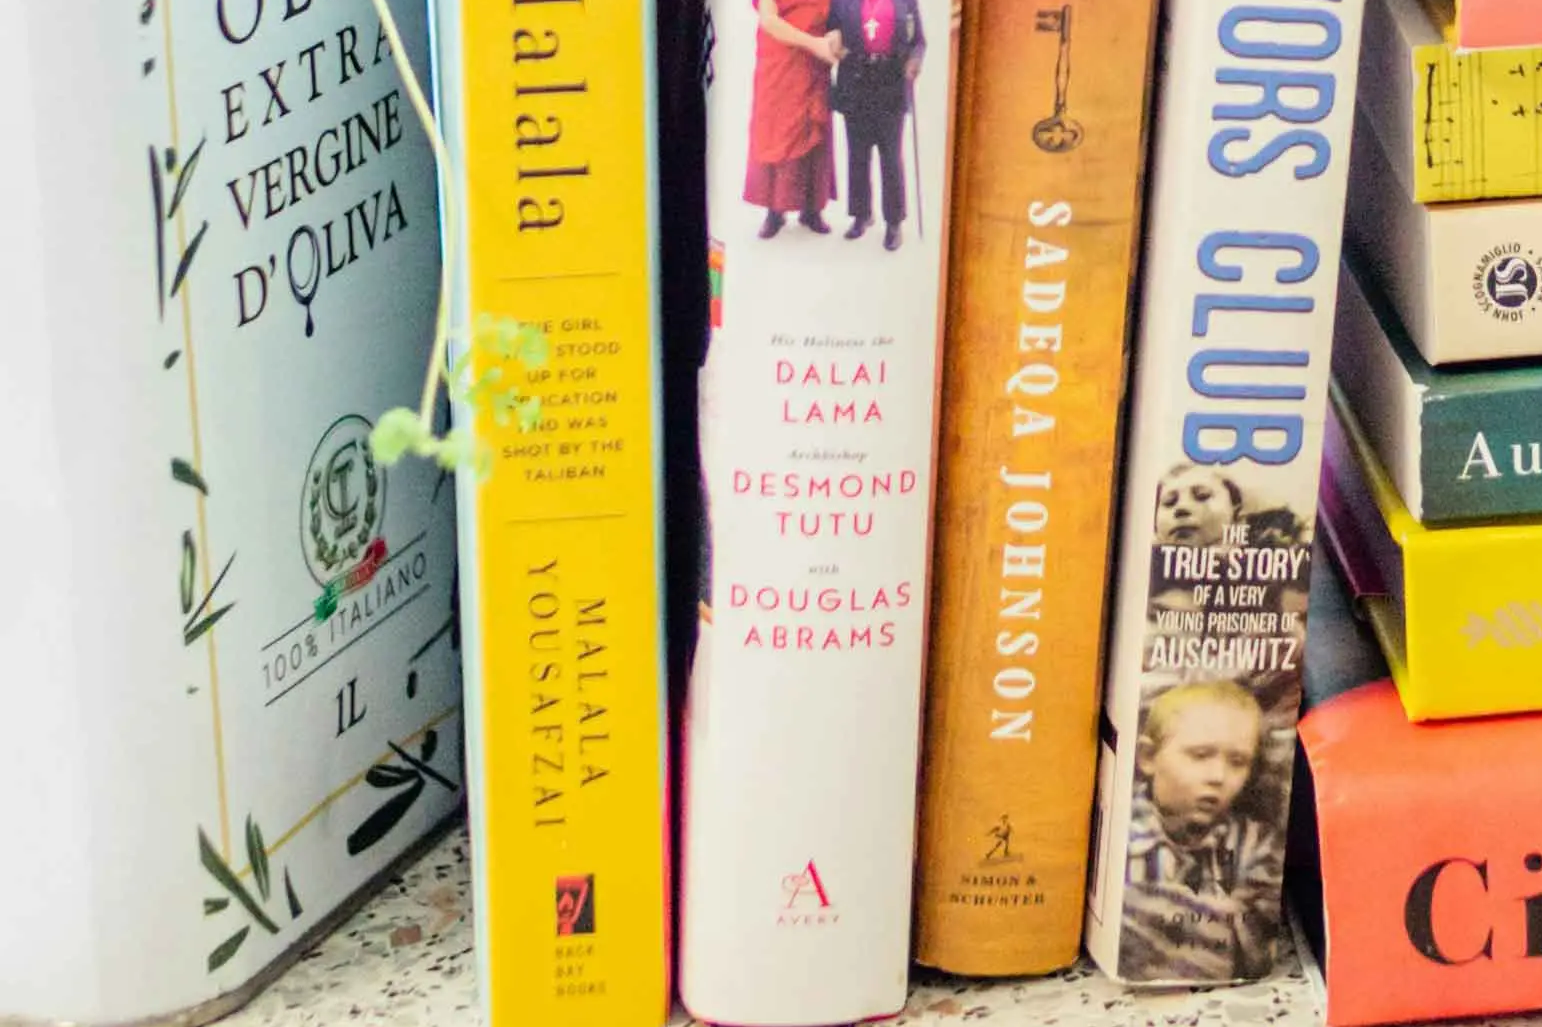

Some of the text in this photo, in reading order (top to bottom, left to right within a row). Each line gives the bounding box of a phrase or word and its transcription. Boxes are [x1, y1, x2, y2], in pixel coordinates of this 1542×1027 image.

[226, 89, 403, 232] VERGINE
[518, 319, 603, 334] TE GIRL
[1493, 307, 1524, 322] JOHN
[556, 341, 621, 358] STOOD
[1182, 229, 1320, 467] CLUB
[527, 368, 597, 384] UP FOR
[776, 359, 886, 386] DALAI
[568, 416, 608, 430] WAS
[783, 399, 883, 425] LAMA
[502, 439, 624, 459] SHOT BY THE
[524, 465, 606, 482] TALIBAN
[989, 199, 1074, 745] SADEQA JOHNSON
[733, 470, 917, 499] DESMOND
[775, 511, 876, 538] TUTU
[1222, 523, 1251, 545] THE
[808, 563, 841, 575] with
[1161, 546, 1304, 581] TRUE STORY
[730, 581, 912, 613] DOUGLAS
[1193, 584, 1267, 607] OF A VERY
[261, 550, 428, 690] 100% ITALIANO
[1156, 611, 1299, 634] YOUNG PRISONER OF
[744, 622, 896, 652] ABRAMS
[1150, 635, 1297, 671] AUSCHWITZ
[527, 557, 567, 830] YOUSAFZAI
[575, 596, 612, 788] MALALA
[960, 874, 1038, 888] SIMON &
[949, 892, 1046, 907] SCHUSTER
[776, 914, 841, 926] AVERY
